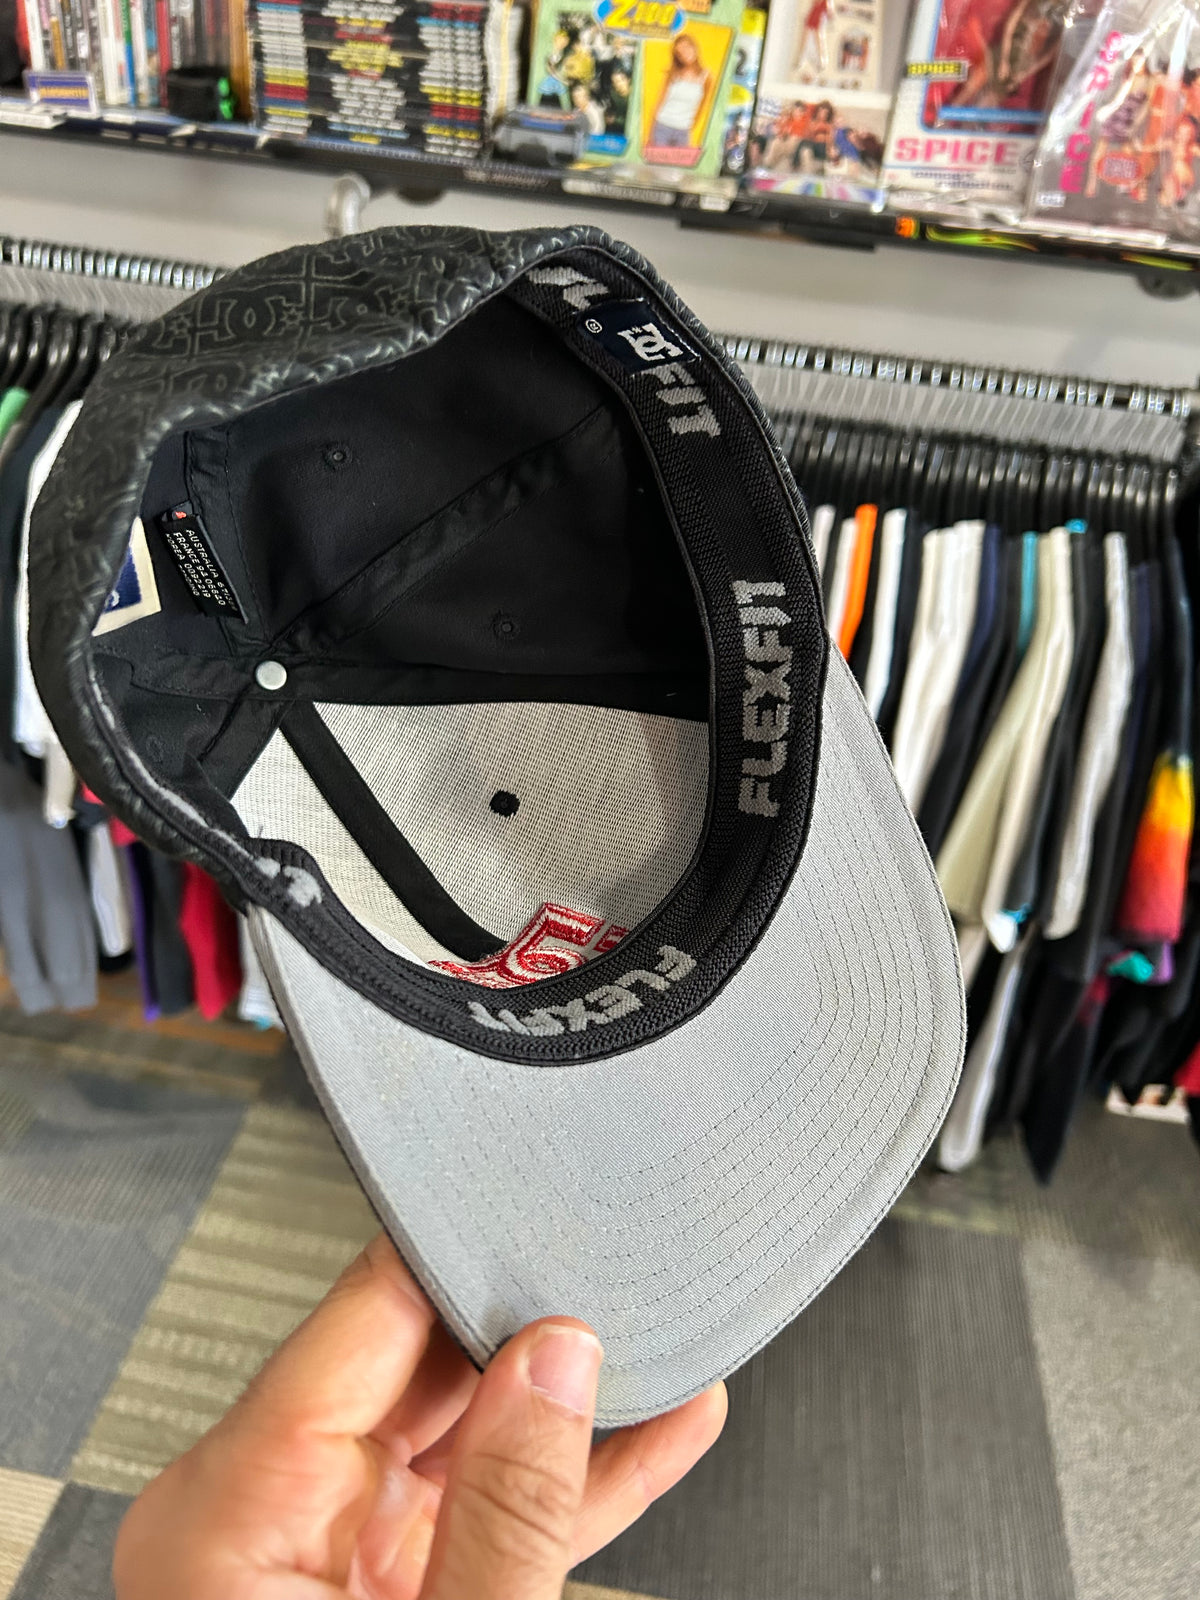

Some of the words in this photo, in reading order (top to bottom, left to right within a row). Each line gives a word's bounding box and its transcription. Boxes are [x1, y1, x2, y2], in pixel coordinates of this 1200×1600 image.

[894, 137, 1020, 167] SPICE
[173, 531, 201, 564] FRANCE
[186, 529, 219, 578] AUSTRALIA
[731, 579, 794, 818] FLEXFIT
[467, 944, 697, 1037] FLEXFIT
